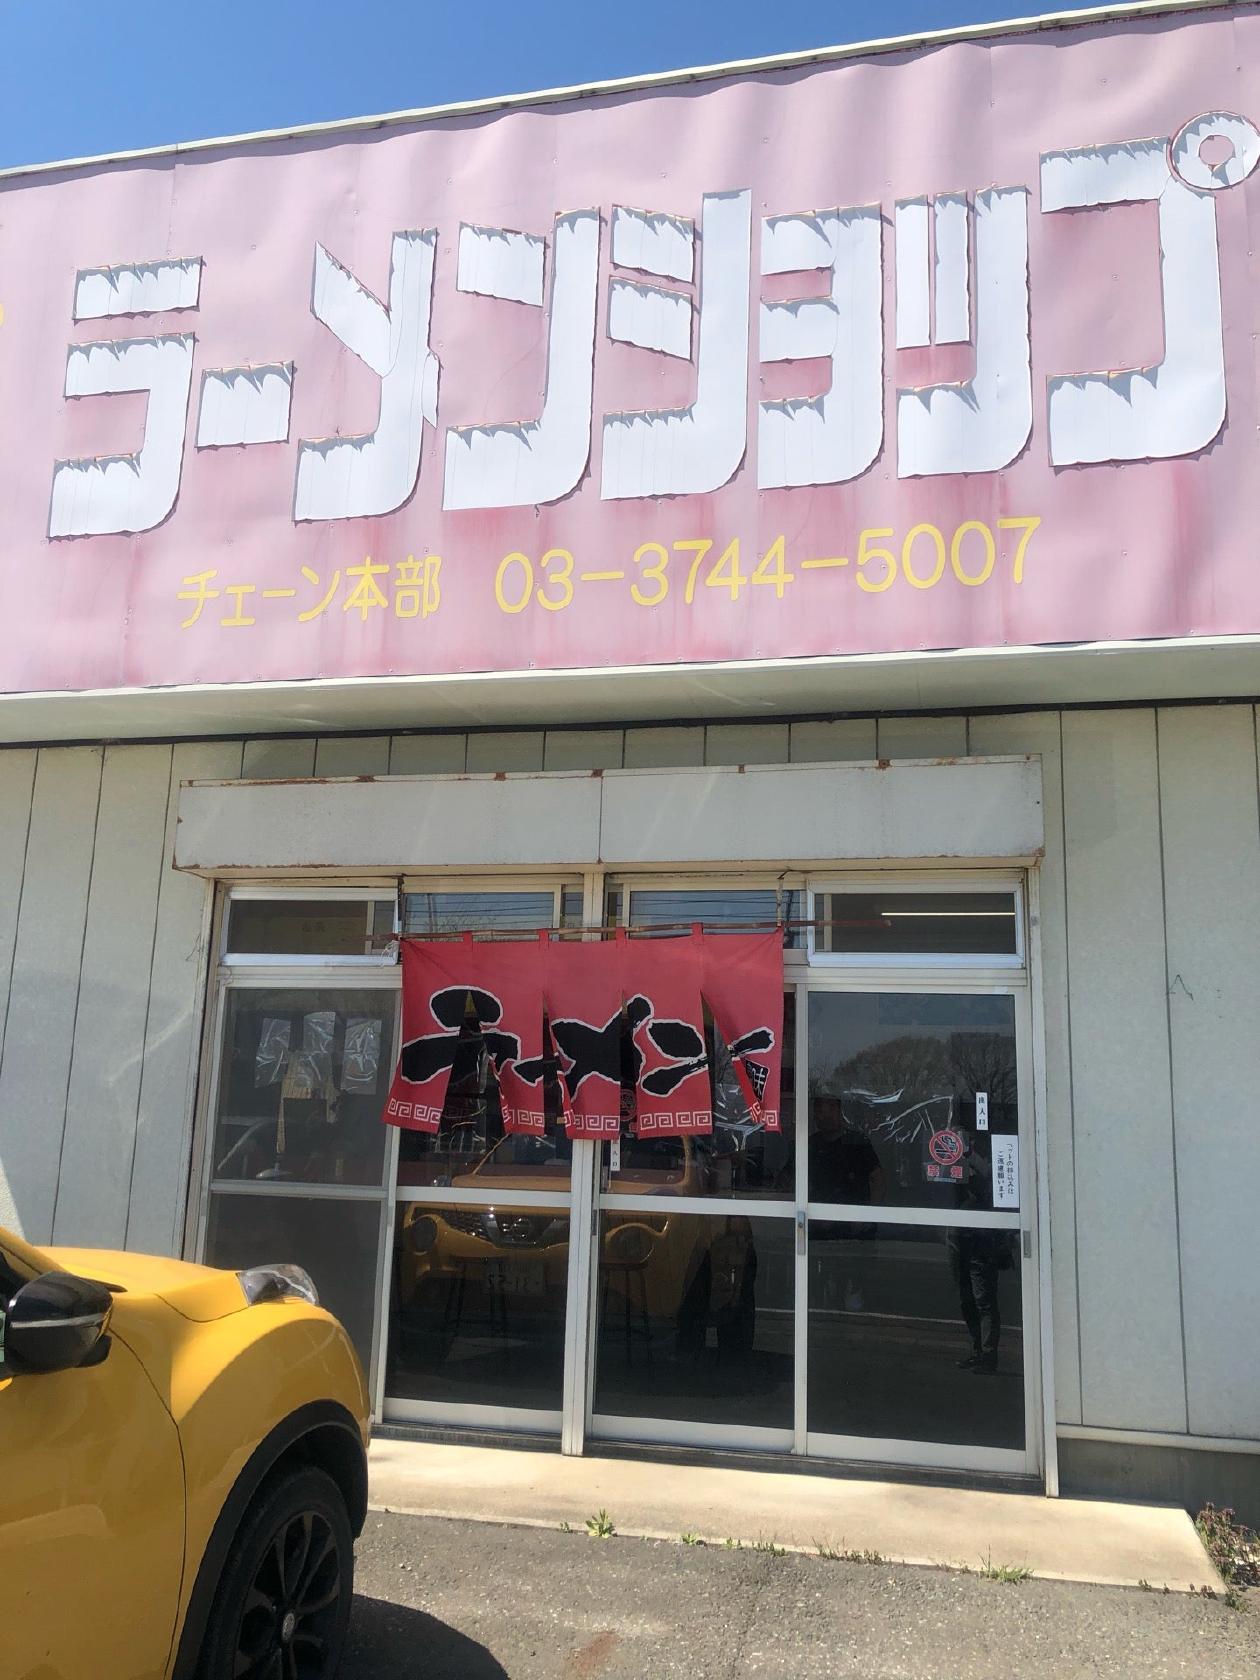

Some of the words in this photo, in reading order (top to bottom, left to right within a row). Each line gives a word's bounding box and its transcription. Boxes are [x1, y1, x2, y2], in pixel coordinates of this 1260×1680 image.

[47, 110, 1260, 539] ラーメンショップ
[177, 555, 443, 630] チェーン本部
